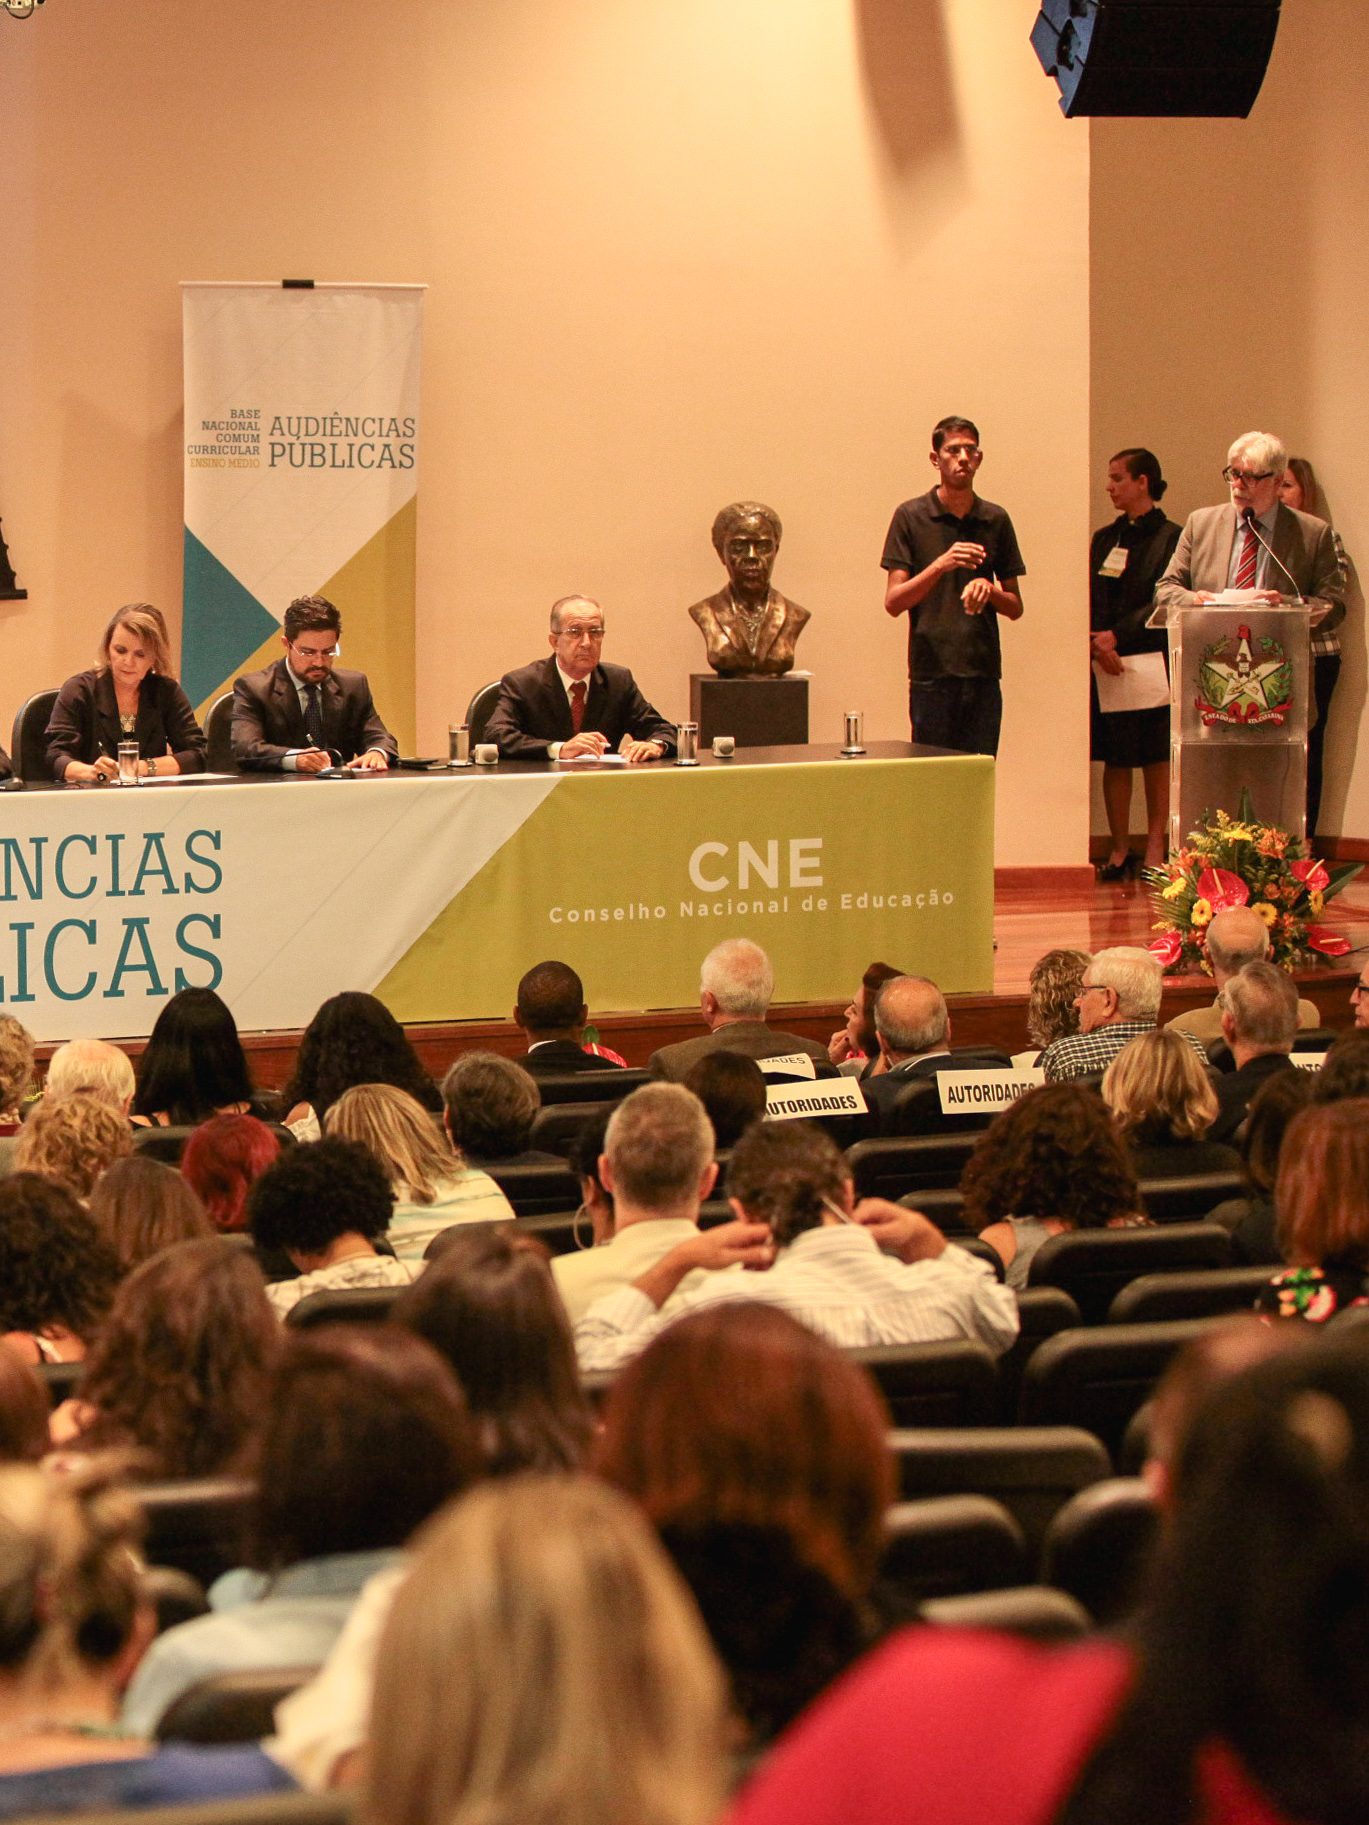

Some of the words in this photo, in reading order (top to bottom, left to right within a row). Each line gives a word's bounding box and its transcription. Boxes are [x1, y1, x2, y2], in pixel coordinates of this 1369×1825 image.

[231, 410, 260, 419] BASE
[202, 421, 260, 431] NACIONAL
[268, 412, 416, 438] AUDIÊNCIAS
[216, 433, 260, 443] COMUM
[187, 445, 260, 455] CURRICULAR
[268, 436, 415, 469] PÚBLICAS
[190, 458, 225, 468] ENSINO
[228, 457, 260, 468] MÉDIO
[688, 838, 823, 893] CNE
[549, 902, 666, 923] Conselho
[680, 896, 788, 917] Nacional
[801, 893, 829, 912] de
[840, 888, 955, 910] Educação
